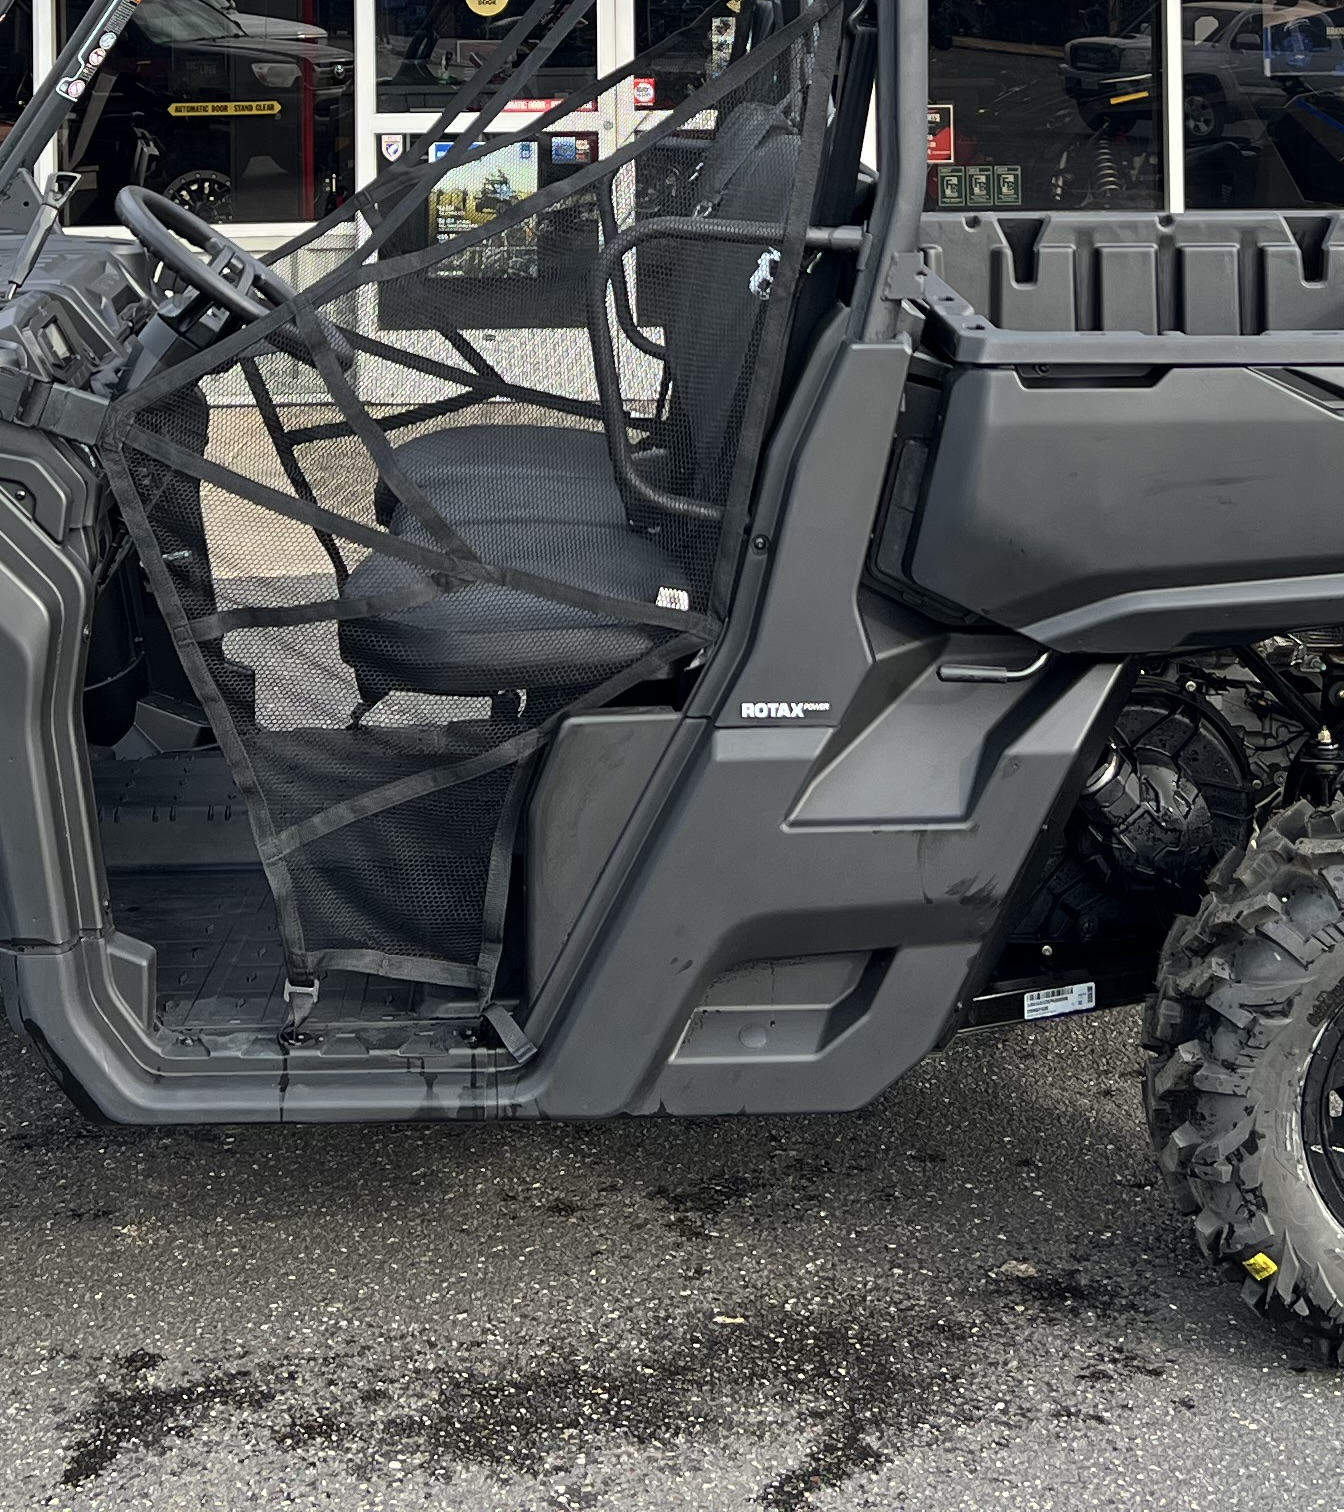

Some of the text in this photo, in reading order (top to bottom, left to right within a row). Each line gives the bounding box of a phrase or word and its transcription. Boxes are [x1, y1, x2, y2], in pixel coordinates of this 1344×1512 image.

[175, 103, 275, 113] AUTOMATIC DOOR STAND CLEAR
[741, 702, 830, 718] ROTAX POWER
